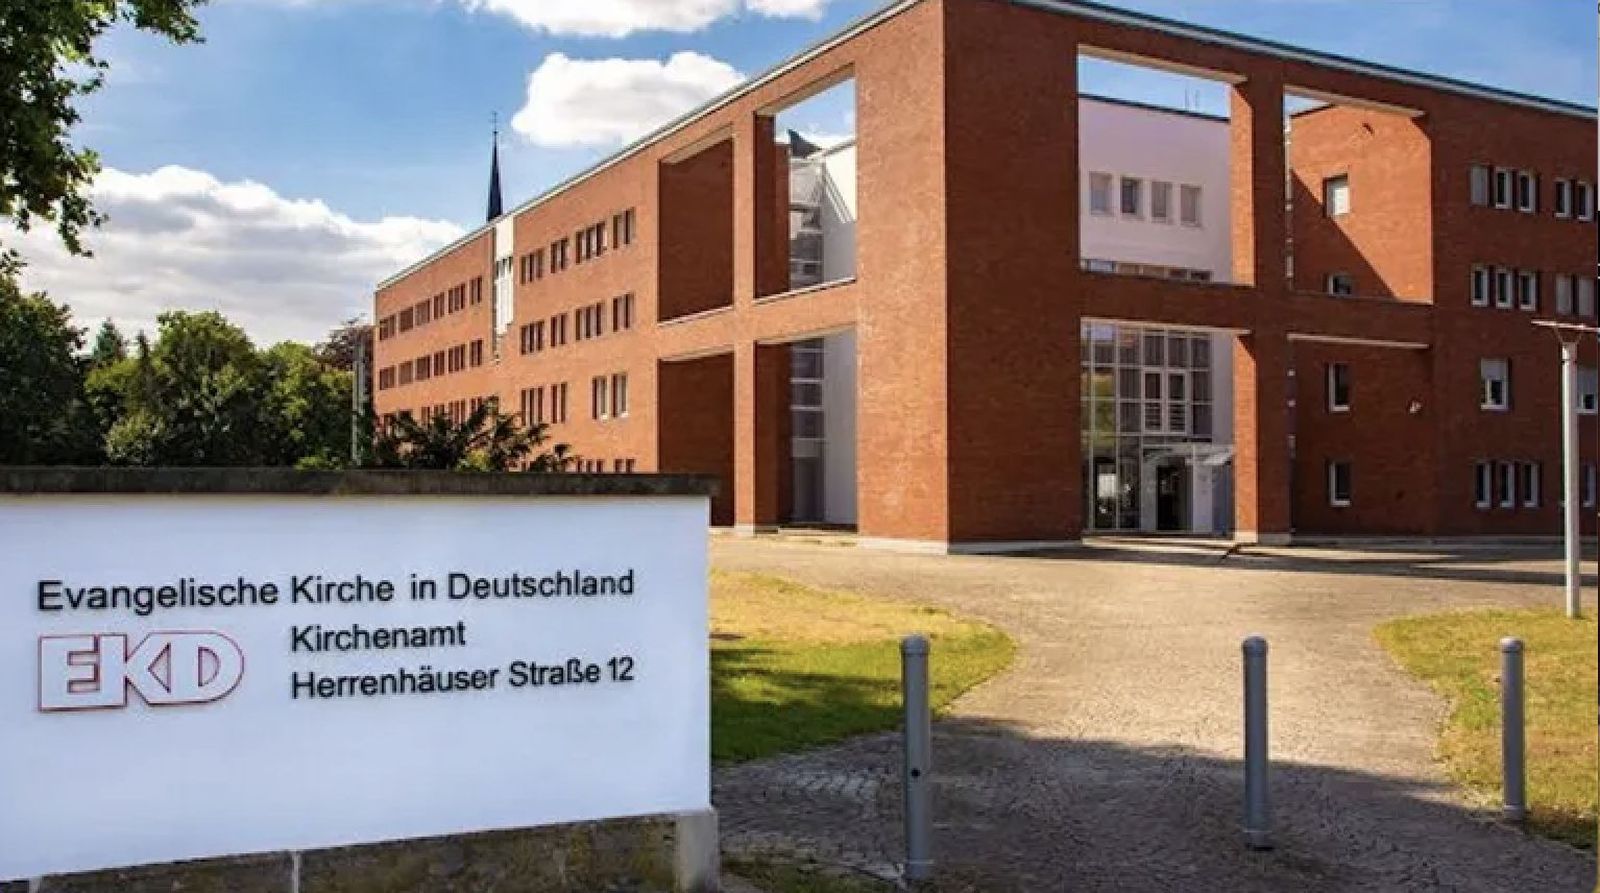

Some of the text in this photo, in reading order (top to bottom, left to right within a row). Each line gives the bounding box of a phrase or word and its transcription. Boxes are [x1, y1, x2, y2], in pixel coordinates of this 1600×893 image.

[37, 569, 635, 616] Evangelische Kirche in Deutschland
[291, 622, 466, 653] Kirchenamt
[37, 630, 245, 713] EKD
[291, 656, 635, 700] Herrenhäuser Straße 12
